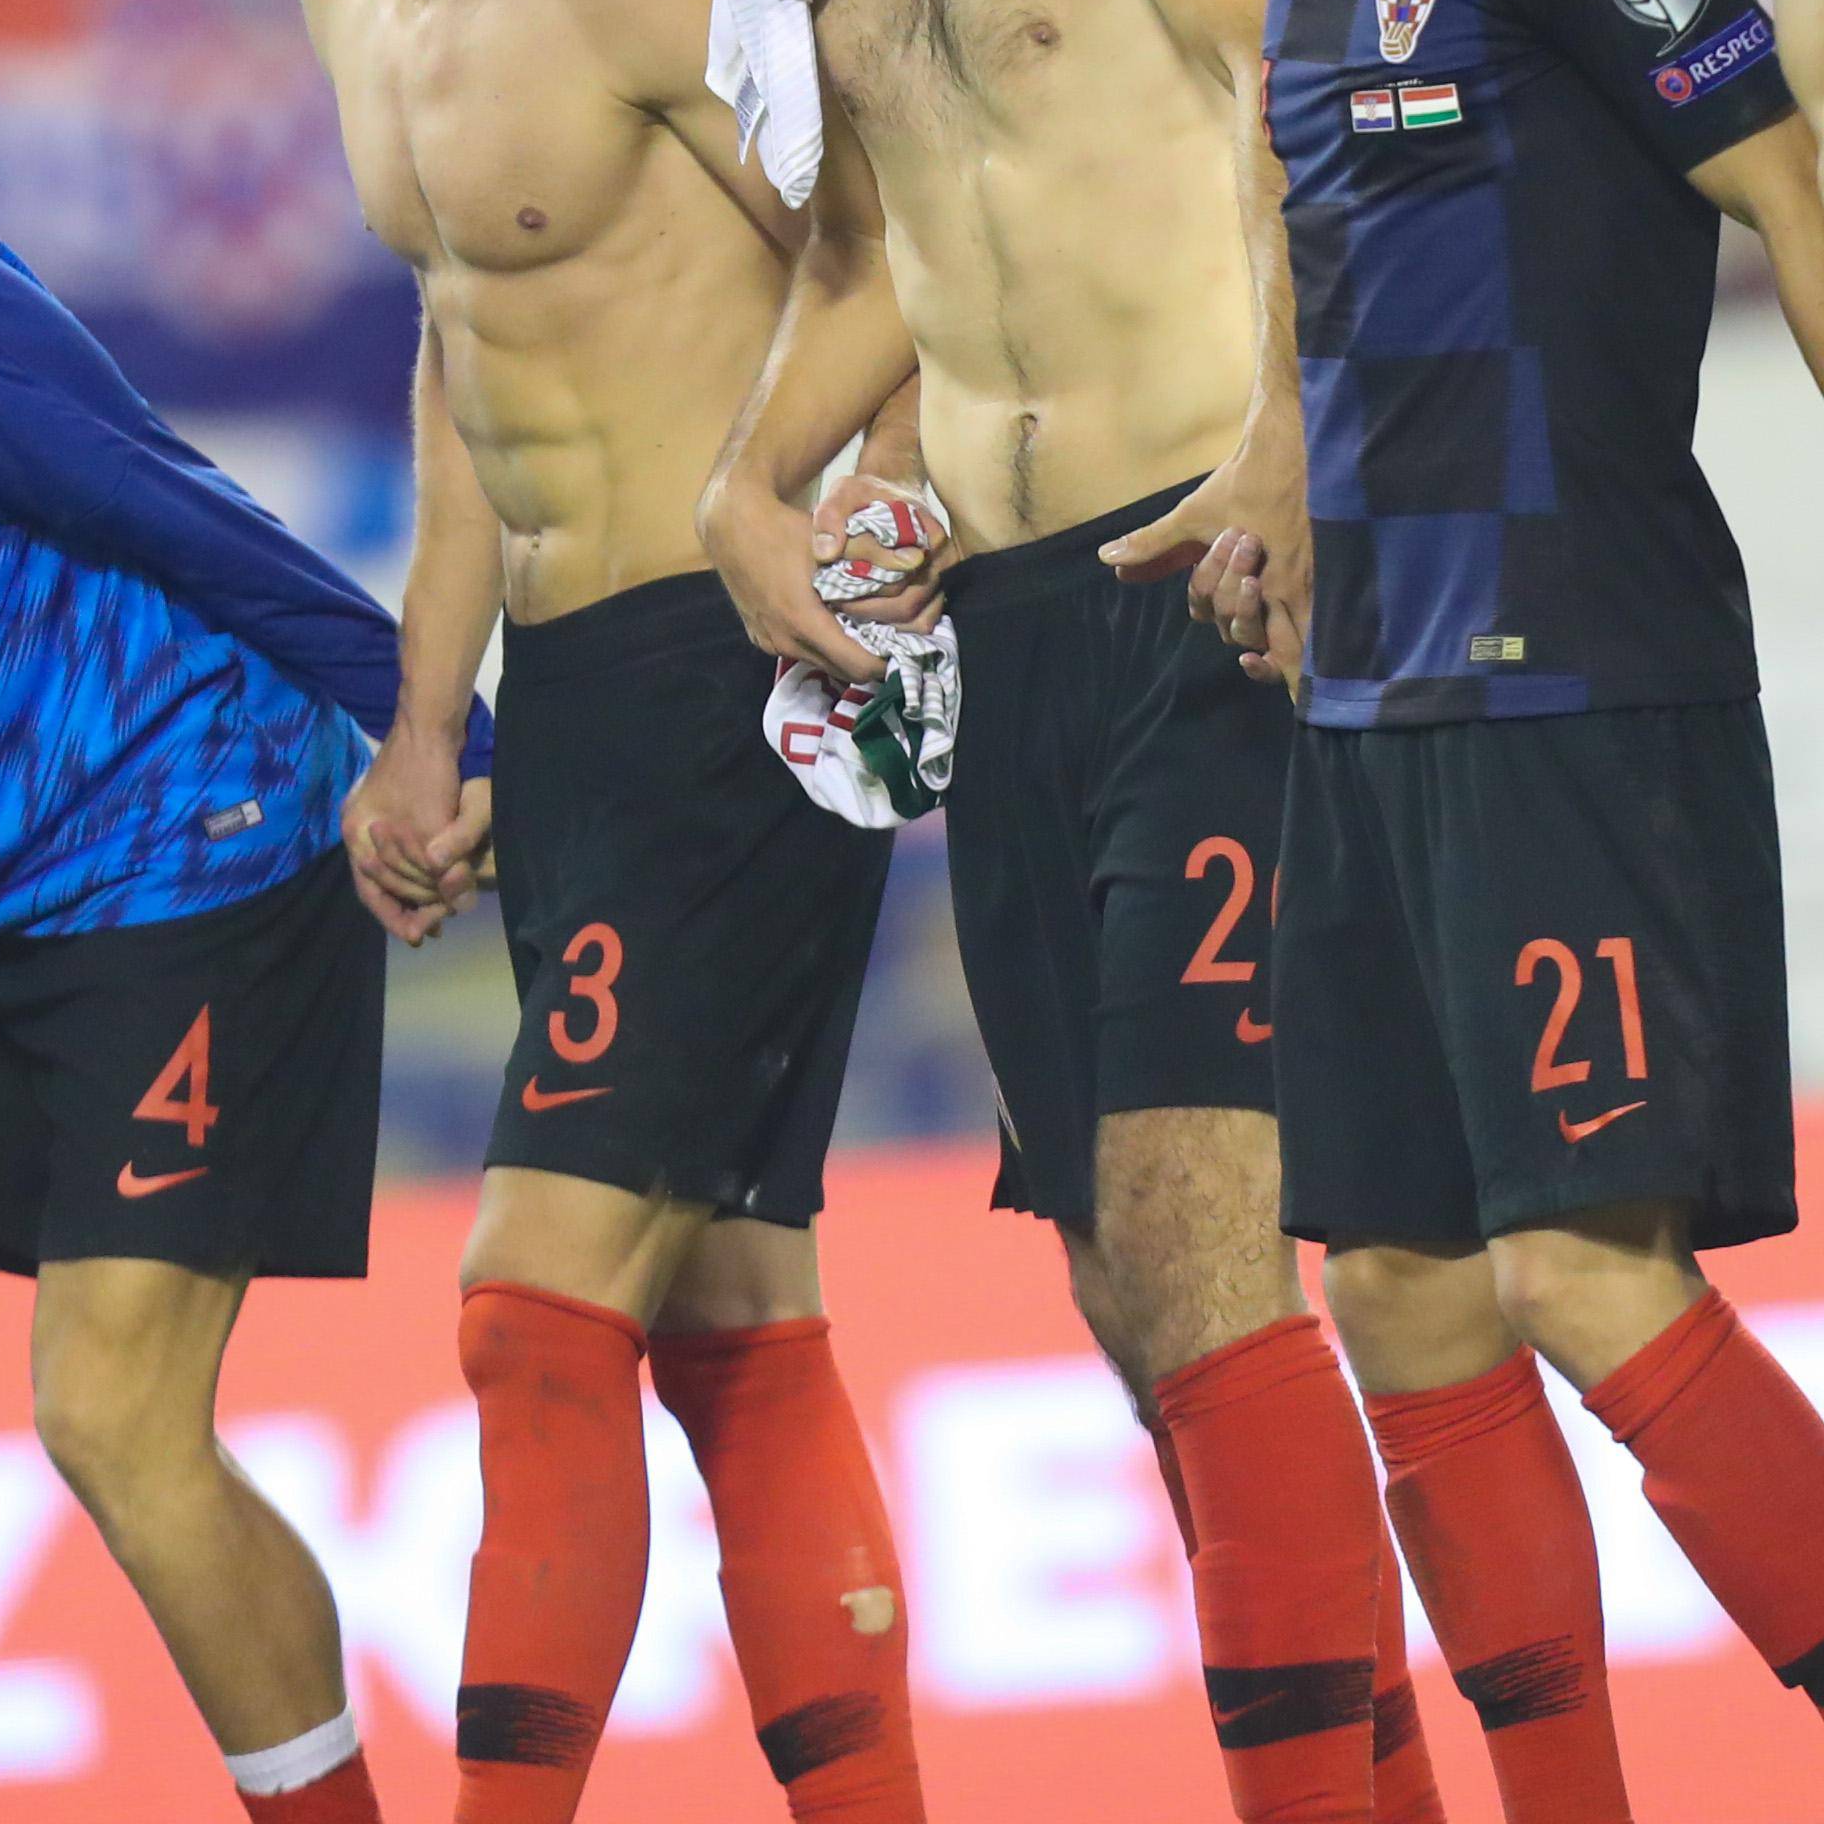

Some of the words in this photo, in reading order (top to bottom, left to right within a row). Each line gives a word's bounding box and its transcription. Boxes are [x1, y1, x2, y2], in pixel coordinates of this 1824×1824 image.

[1180, 835, 1282, 985] 2
[547, 921, 625, 1064] 3
[1514, 936, 1649, 1093] 21
[131, 1004, 220, 1148] 4
